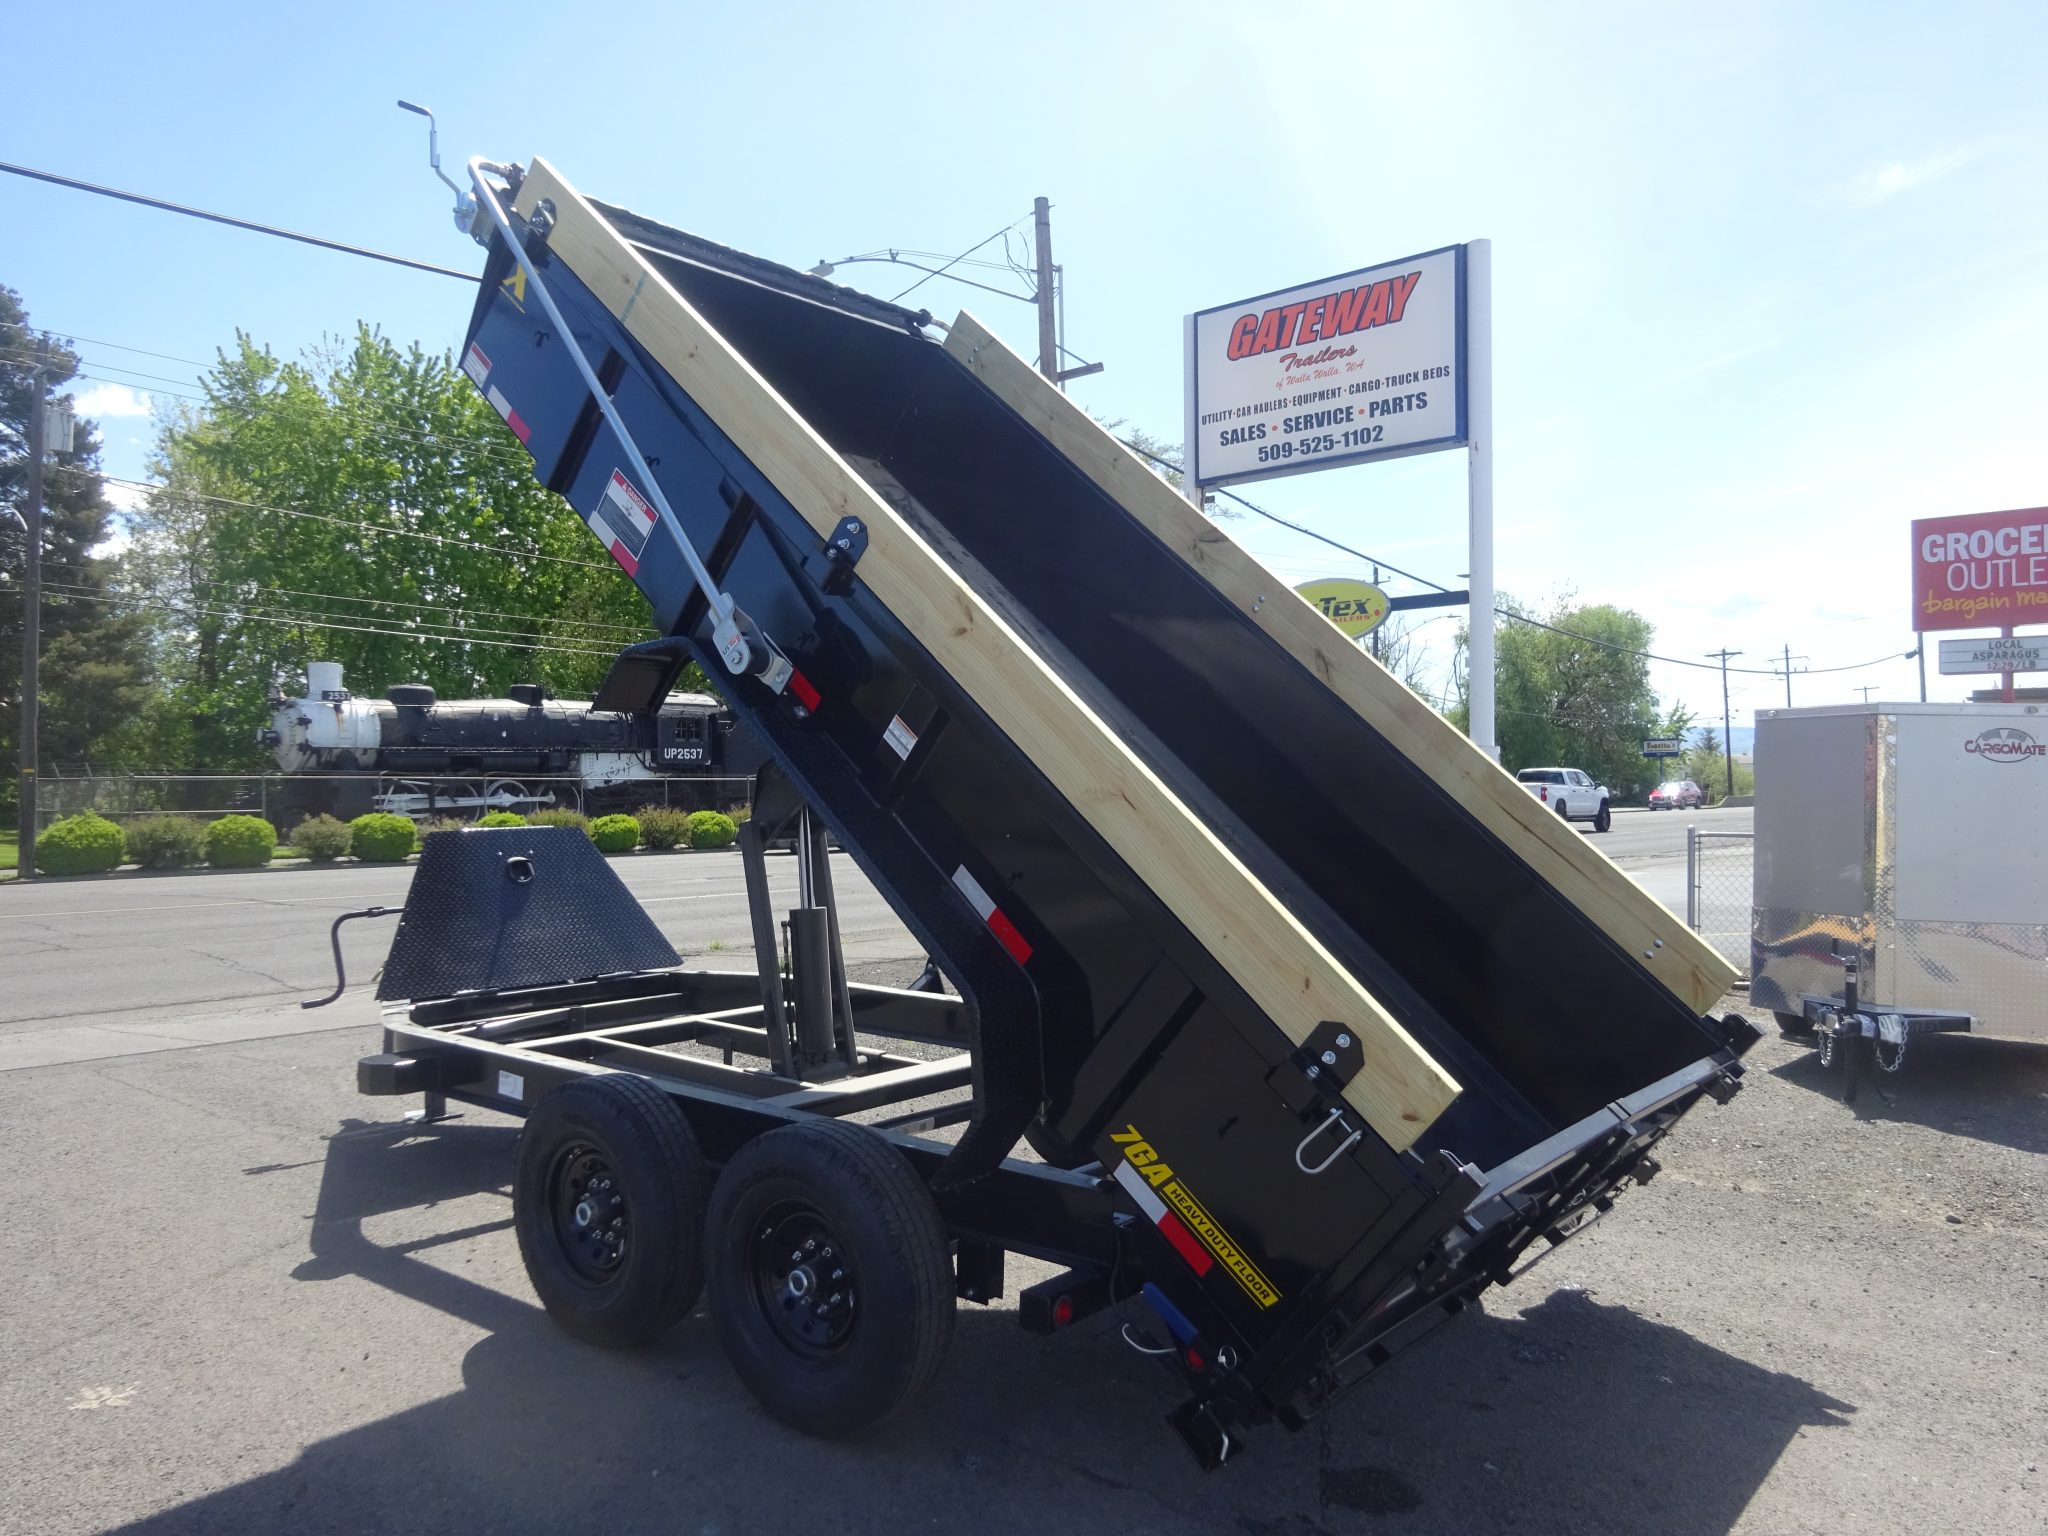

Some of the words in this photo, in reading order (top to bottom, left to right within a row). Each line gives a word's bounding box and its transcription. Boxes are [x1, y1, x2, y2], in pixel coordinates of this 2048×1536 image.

[1227, 271, 1422, 361] GATEWAY
[1275, 378, 1284, 390] of
[1286, 374, 1311, 386] Walla
[1345, 358, 1365, 373] WA
[1279, 345, 1357, 372] Trailers
[1201, 409, 1232, 426] UTILITY
[1236, 404, 1251, 418] CAR
[1253, 398, 1288, 415] HAULERS
[1292, 387, 1342, 407] EQUIPMENT
[1348, 379, 1380, 396] CARGO
[1384, 371, 1420, 388] TRUCK
[1422, 365, 1450, 381] BEDS
[1219, 423, 1267, 447] SALES
[1283, 405, 1354, 434] SERVICE
[1369, 391, 1428, 418] PARTS
[1258, 424, 1384, 463] 509-525-1102
[627, 486, 648, 513] DANGER
[1947, 556, 2048, 591] OUTLE
[1331, 615, 1370, 623] AILERS
[1921, 589, 2009, 619] bargain
[2016, 590, 2048, 607] ma
[1972, 649, 2040, 661] ASPARAGUS
[1988, 640, 2023, 650] LOCAL
[328, 692, 352, 700] 2537
[664, 747, 703, 759] UP2537
[1109, 1124, 1174, 1187] 7GA
[1170, 1188, 1207, 1226] HEAVY
[1204, 1228, 1236, 1259] DUTY
[1232, 1260, 1271, 1300] FLOOR
